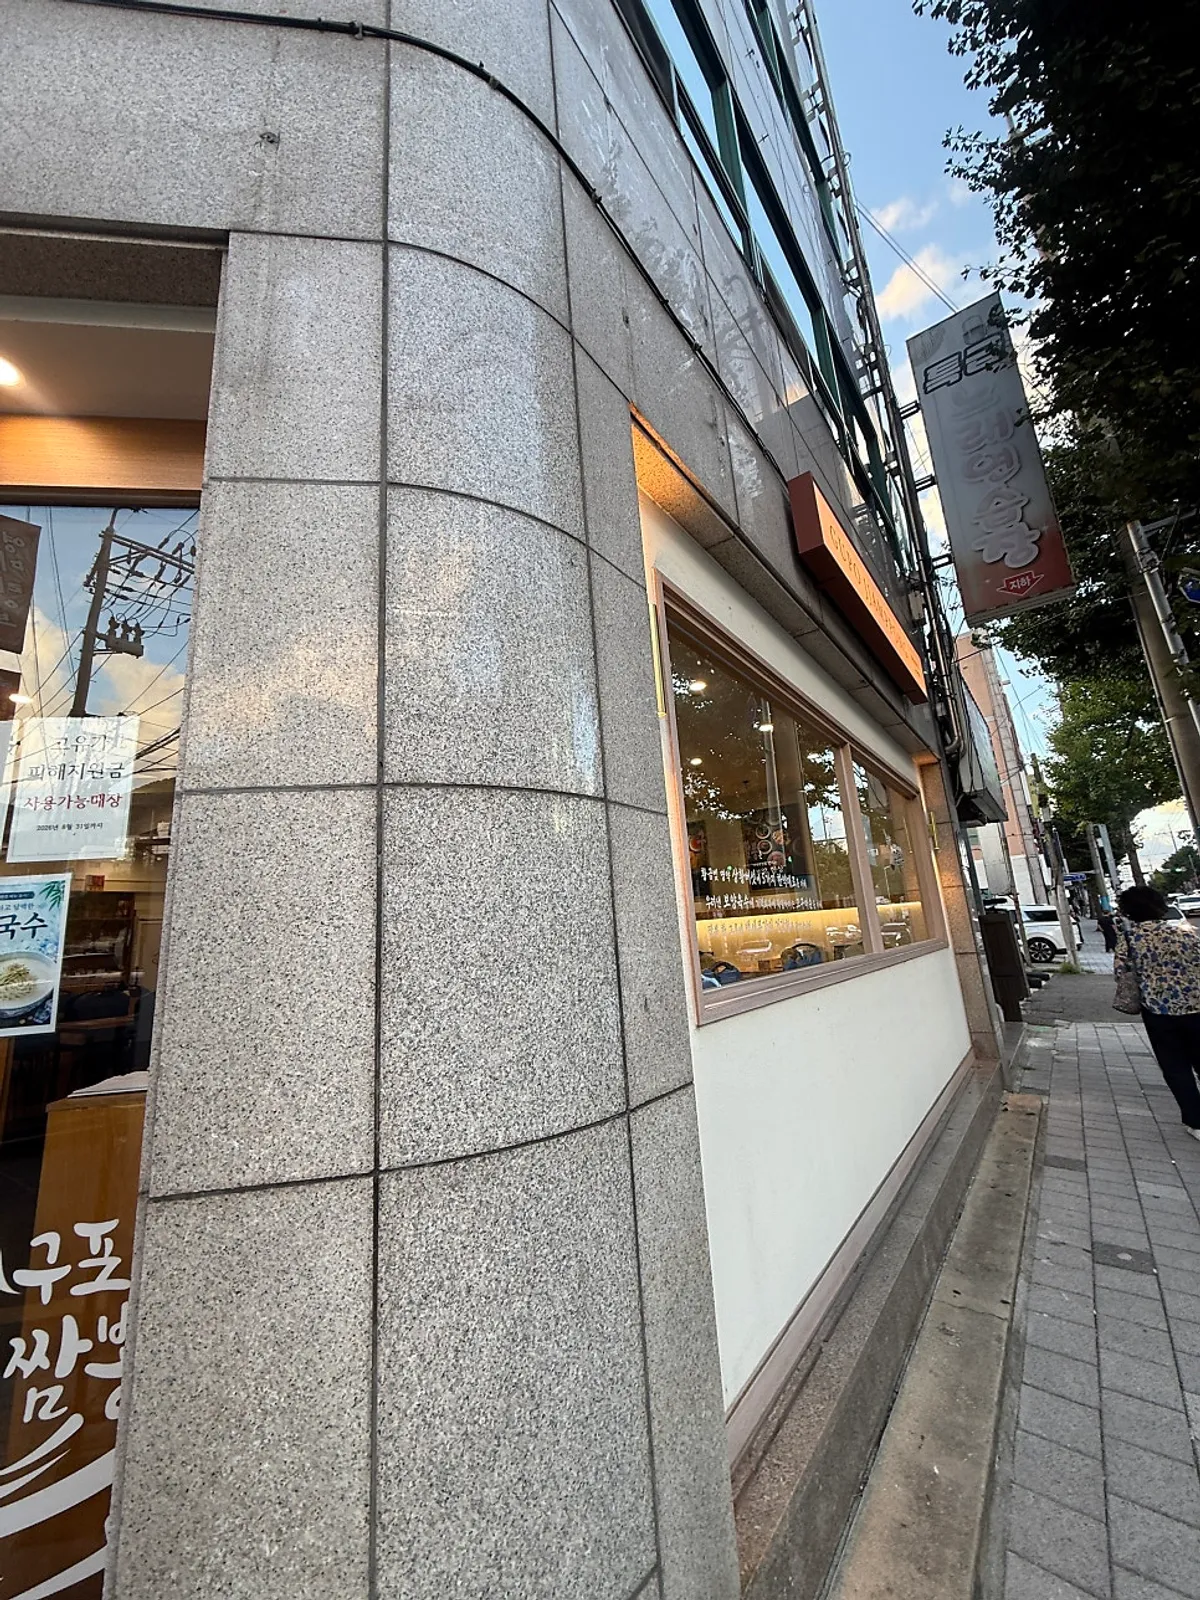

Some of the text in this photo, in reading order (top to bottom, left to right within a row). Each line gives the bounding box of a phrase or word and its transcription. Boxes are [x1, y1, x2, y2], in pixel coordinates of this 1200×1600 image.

[1008, 575, 1032, 591] 지하
[49, 734, 109, 753] 고유가
[28, 761, 125, 781] 피해지원금
[0, 912, 48, 940] 국수
[13, 1219, 131, 1305] 구포
